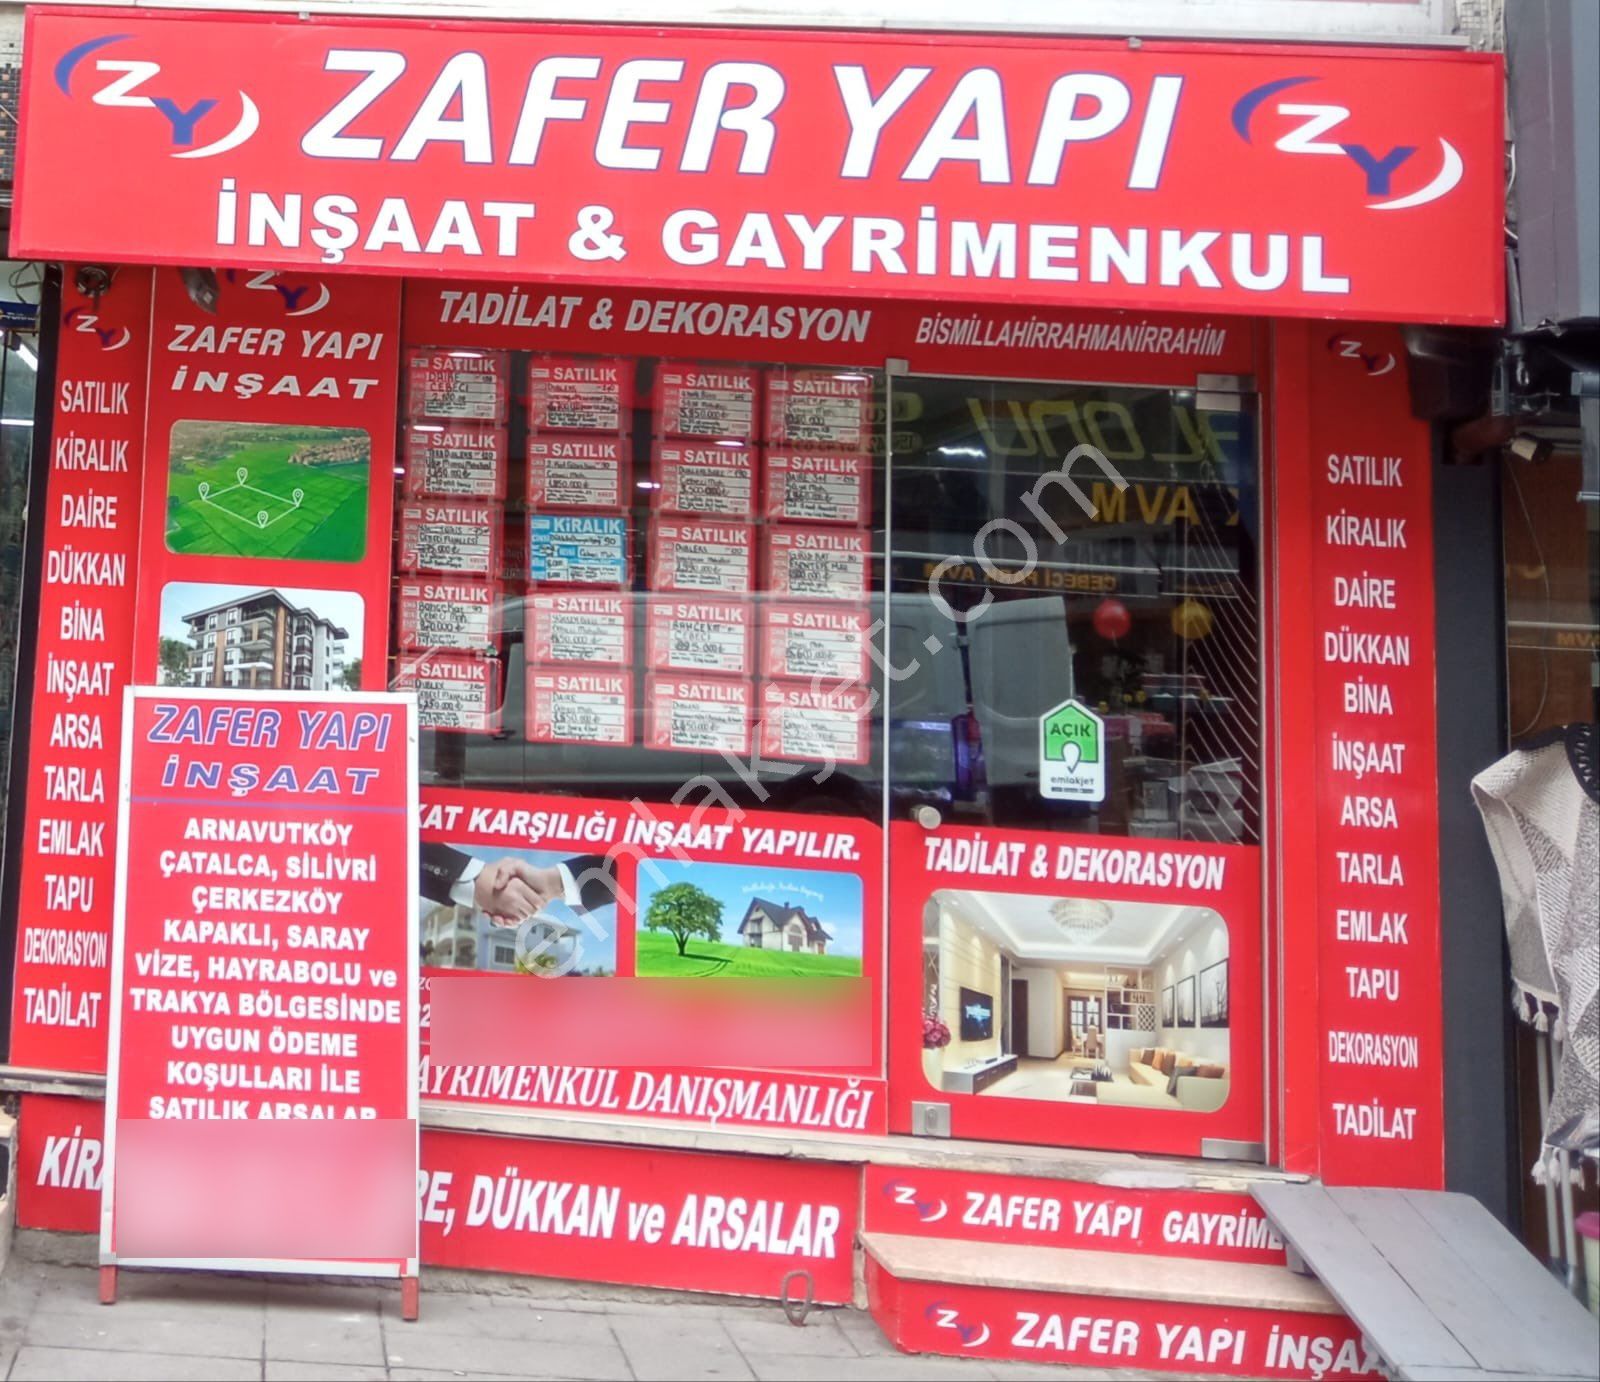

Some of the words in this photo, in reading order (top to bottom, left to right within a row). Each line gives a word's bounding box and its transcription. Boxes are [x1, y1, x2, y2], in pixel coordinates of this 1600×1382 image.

[302, 51, 784, 173] ZAFER
[834, 66, 1182, 188] YAPI
[218, 179, 534, 263] İNŞAAT
[569, 206, 626, 260] &
[663, 206, 1349, 292] GAYRİMENKUL
[440, 286, 580, 329] TADİLAT
[589, 298, 613, 330] &
[625, 300, 871, 342] DEKORASYON
[168, 325, 285, 355] ZAFER
[302, 331, 383, 360] YAPI
[915, 312, 1225, 355] BİSMİLLAHİRRAHMANİRRAHİM
[432, 357, 495, 372] SATILIK
[553, 367, 617, 382] SATILIK
[686, 374, 751, 389] SATILIK
[61, 380, 129, 414] SATILIK
[172, 366, 378, 399] İNŞAAT
[793, 380, 858, 396] SATILIK
[56, 432, 128, 472] KİRALIK
[432, 433, 495, 448] SATILIK
[552, 443, 616, 458] SATILIK
[684, 450, 749, 466] SATILIK
[792, 457, 858, 473] SATILIK
[1328, 454, 1402, 486] SATILIK
[61, 489, 117, 528] DAİRE
[425, 509, 488, 523] SATILIK
[681, 527, 747, 543] SATILIK
[795, 534, 861, 550] SATILIK
[1327, 509, 1406, 548] KİRALIK
[47, 545, 125, 586] DÜKKAN
[424, 585, 488, 601] SATILIK
[558, 599, 622, 613] SATILIK
[1335, 571, 1395, 609] DAİRE
[61, 600, 104, 641] BİNA
[677, 605, 743, 621] SATILIK
[793, 613, 860, 630] SATILIK
[1325, 626, 1409, 665] DÜKKAN
[47, 653, 114, 703] İNŞAAT
[421, 664, 484, 679] SATILIK
[558, 677, 623, 692] SATILIK
[679, 684, 744, 700] SATILIK
[789, 692, 856, 709] SATILIK
[1344, 676, 1393, 714] BİNA
[50, 714, 102, 749] ARSA
[147, 704, 281, 748] ZAFER
[298, 710, 392, 752] YAPI
[1051, 724, 1091, 737] AÇIK
[1333, 733, 1405, 779] İNŞAAT
[44, 766, 104, 802] TARLA
[161, 754, 379, 797] İNŞAAT
[1050, 776, 1095, 787] emlakjet
[1341, 796, 1397, 828] ARSA
[38, 819, 104, 856] EMLAK
[184, 818, 352, 846] ARNAVUTKÖY
[468, 808, 616, 843] KARŞILIĞI
[623, 813, 732, 851] İNŞAAT
[742, 827, 859, 860] YAPILIR.
[160, 850, 278, 881] ÇATALCA,
[286, 852, 376, 881] SİLİVRİ
[925, 833, 1025, 876] TADİLAT
[1030, 844, 1048, 878] &
[1056, 846, 1225, 890] DEKORASYON
[1336, 852, 1403, 885] TARLA
[45, 875, 93, 912] TAPU
[192, 886, 342, 914] ÇERKEZKÖY
[164, 919, 278, 951] KAPAKLI,
[287, 925, 369, 950] SARAY
[1337, 910, 1408, 944] EMLAK
[24, 928, 107, 967] DEKORASYON
[135, 949, 199, 982] VİZE,
[208, 957, 360, 985] HAYRABOLU
[369, 970, 397, 987] ve
[1346, 967, 1398, 1000] TAPU
[24, 983, 101, 1027] TADİLAT
[130, 988, 230, 1014] TRAKYA
[239, 990, 400, 1023] BÖLGESİNDE
[172, 1026, 260, 1052] UYGUN
[269, 1026, 357, 1057] ÖDEME
[1329, 1031, 1418, 1067] DEKORASYON
[168, 1061, 311, 1091] KOŞULLARI
[321, 1064, 360, 1093] İLE
[149, 1095, 248, 1119] SATILIK
[626, 1078, 873, 1128] DANIŞMANLIĞI
[1333, 1099, 1416, 1139] TADİLAT
[466, 1167, 620, 1238] DÜKKAN
[629, 1203, 665, 1243] ve
[671, 1194, 839, 1258] ARSALAR
[963, 1192, 1061, 1231] ZAFER
[1074, 1202, 1142, 1238] YAPI
[1012, 1312, 1139, 1355] ZAFER
[1157, 1324, 1245, 1364] YAPI
